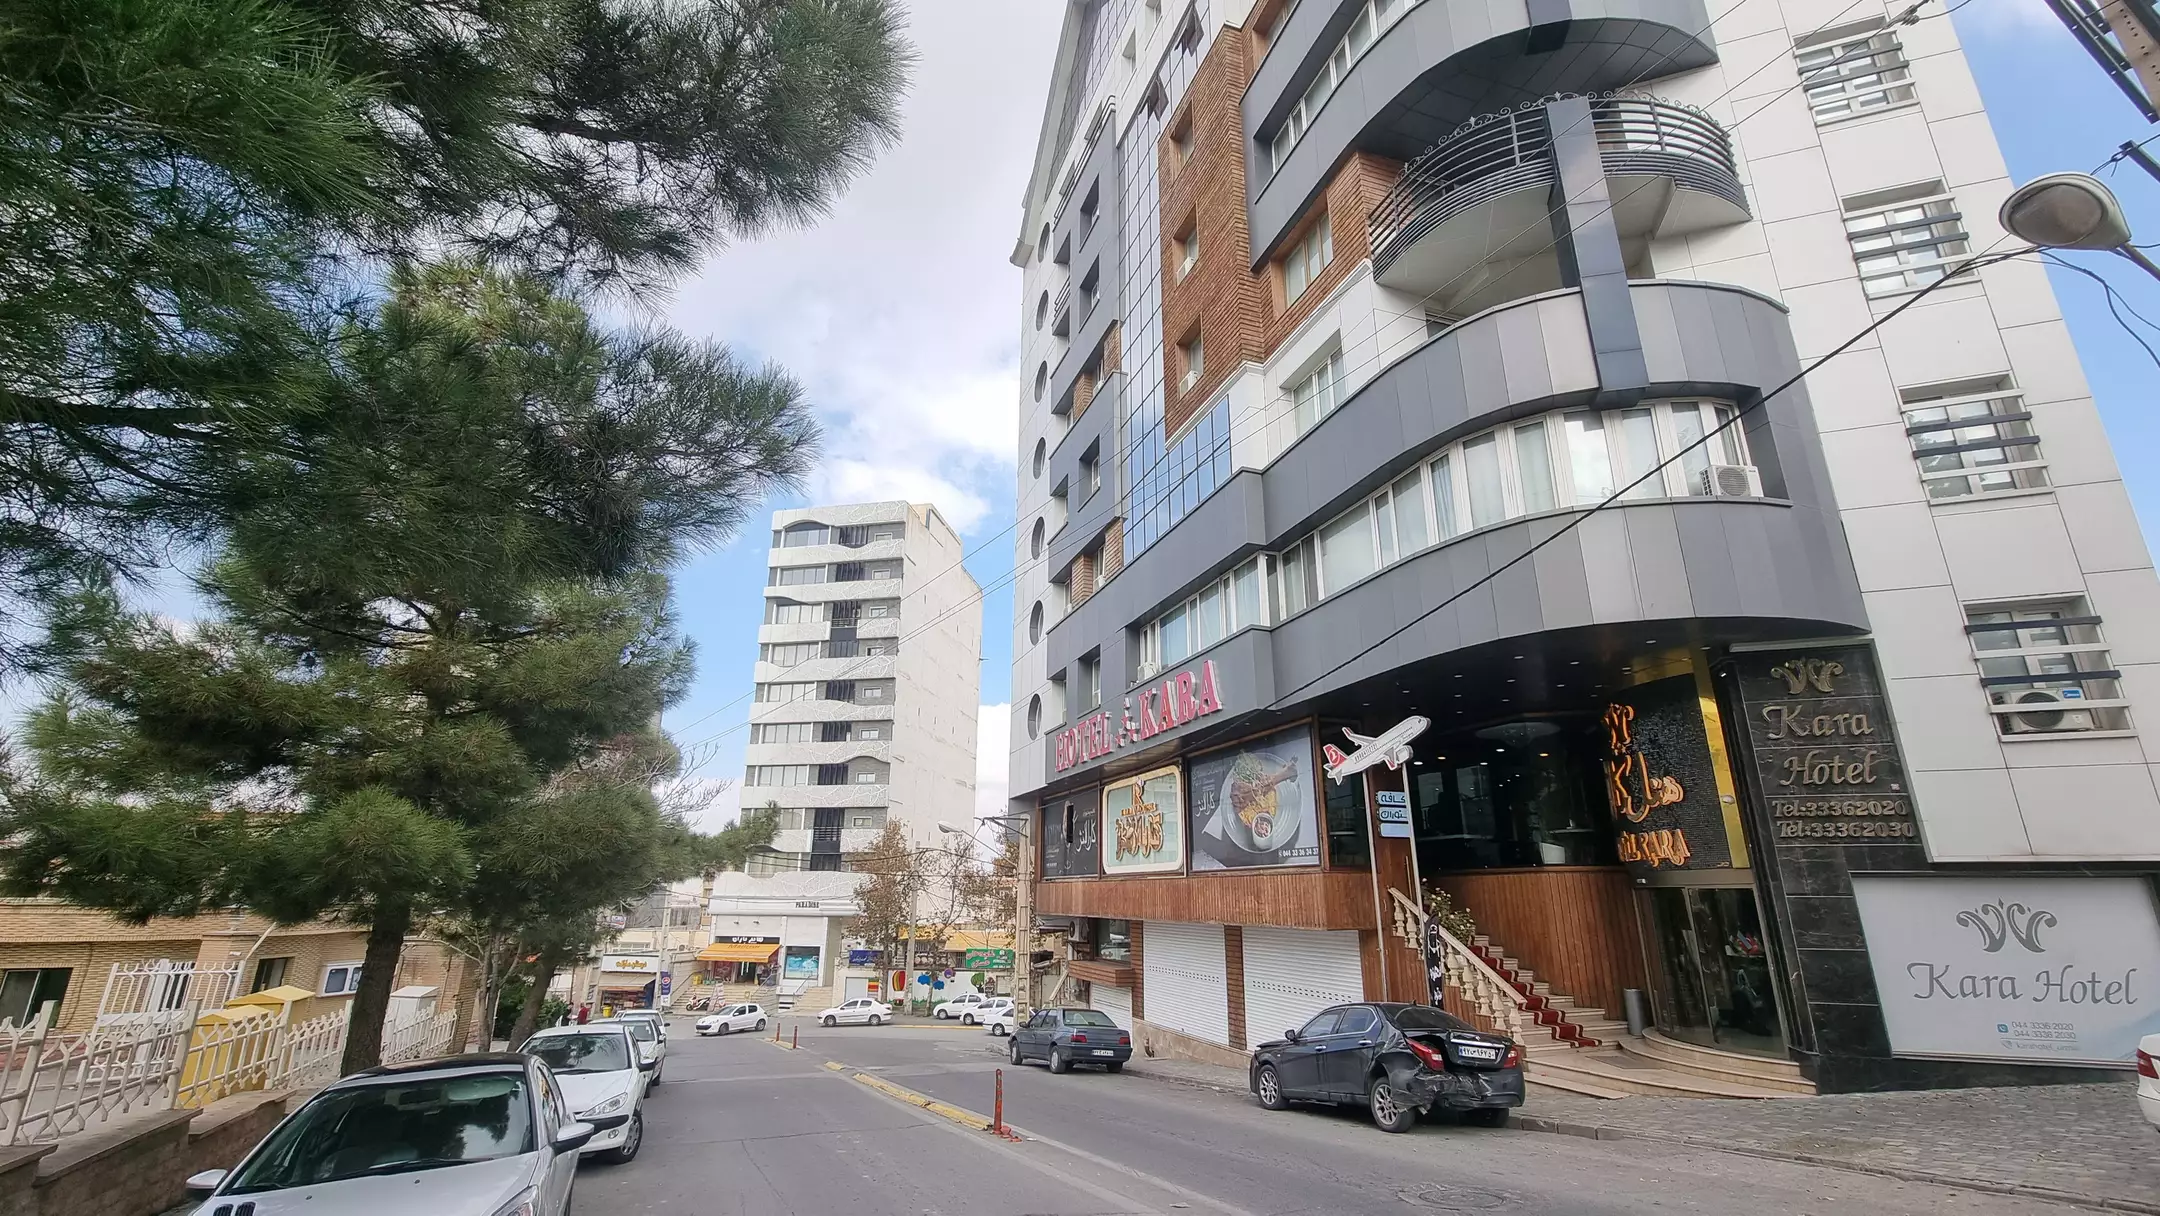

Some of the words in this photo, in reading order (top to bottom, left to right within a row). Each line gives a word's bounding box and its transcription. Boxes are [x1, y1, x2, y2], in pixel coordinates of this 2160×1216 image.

[1055, 711, 1113, 773] HOTEL
[1138, 659, 1223, 741] KARA
[1761, 704, 1874, 740] Kara
[1779, 750, 1880, 787] Hotel
[1381, 792, 1406, 803] کافه
[1906, 962, 2023, 1000] Kara
[2032, 964, 2138, 1006] Hotel
[2052, 1022, 2074, 1031] 2020
